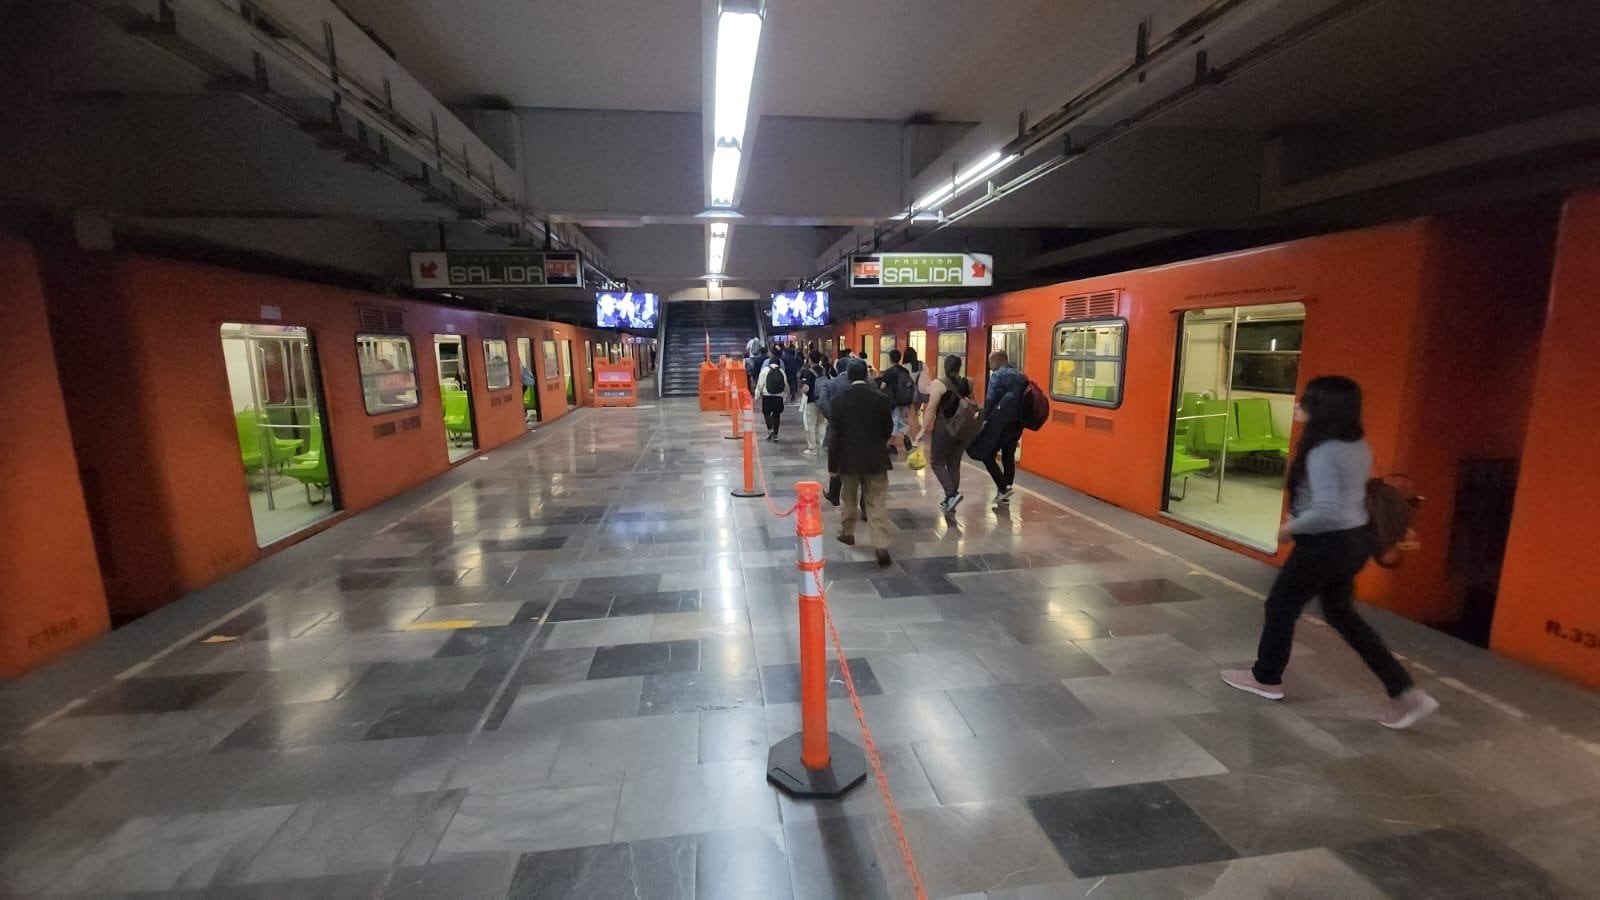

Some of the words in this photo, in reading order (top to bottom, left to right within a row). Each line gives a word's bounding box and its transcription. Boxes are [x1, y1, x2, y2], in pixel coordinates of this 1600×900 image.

[450, 266, 544, 283] SALIDA
[883, 267, 963, 283] SALIDA
[1545, 619, 1600, 650] R.33
